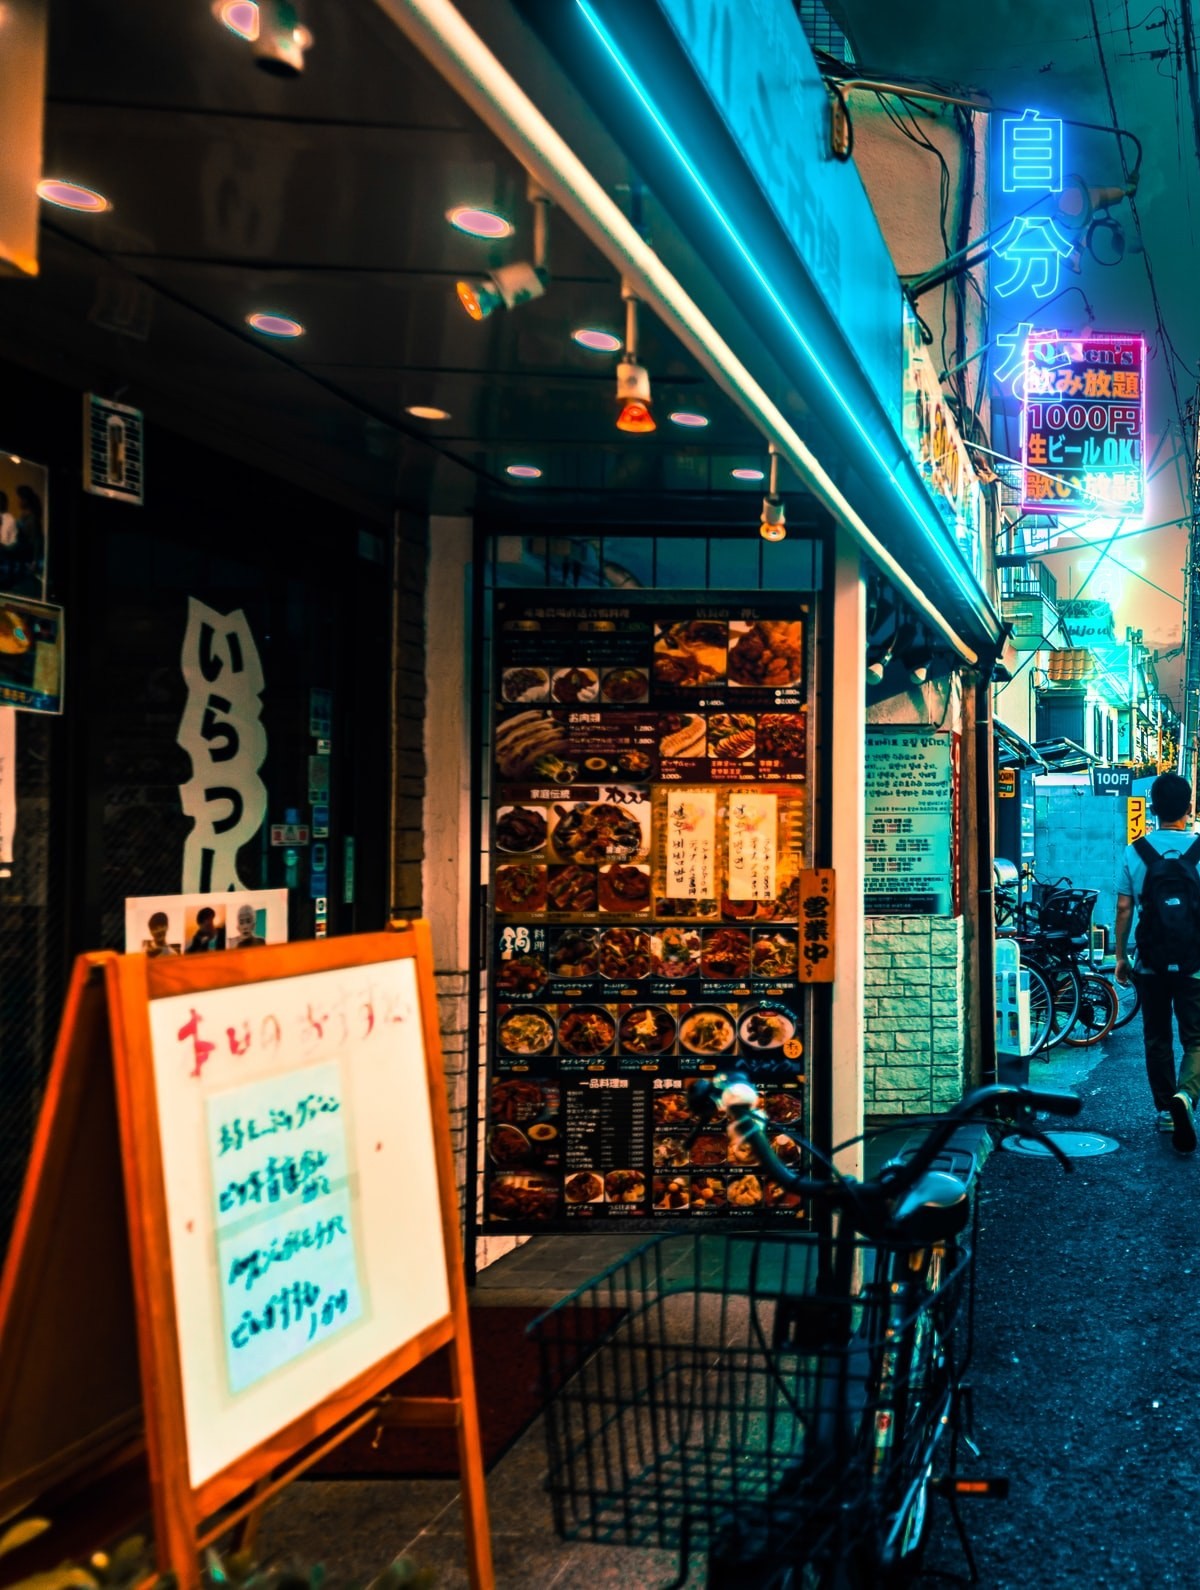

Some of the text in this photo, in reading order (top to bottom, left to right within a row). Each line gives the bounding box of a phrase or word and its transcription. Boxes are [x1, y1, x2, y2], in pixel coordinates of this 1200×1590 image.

[1027, 368, 1140, 399] 飲み放題
[1028, 404, 1140, 435] 1000円
[1097, 773, 1130, 785] 100円
[1130, 800, 1142, 840] コイン
[803, 895, 830, 965] 営業中
